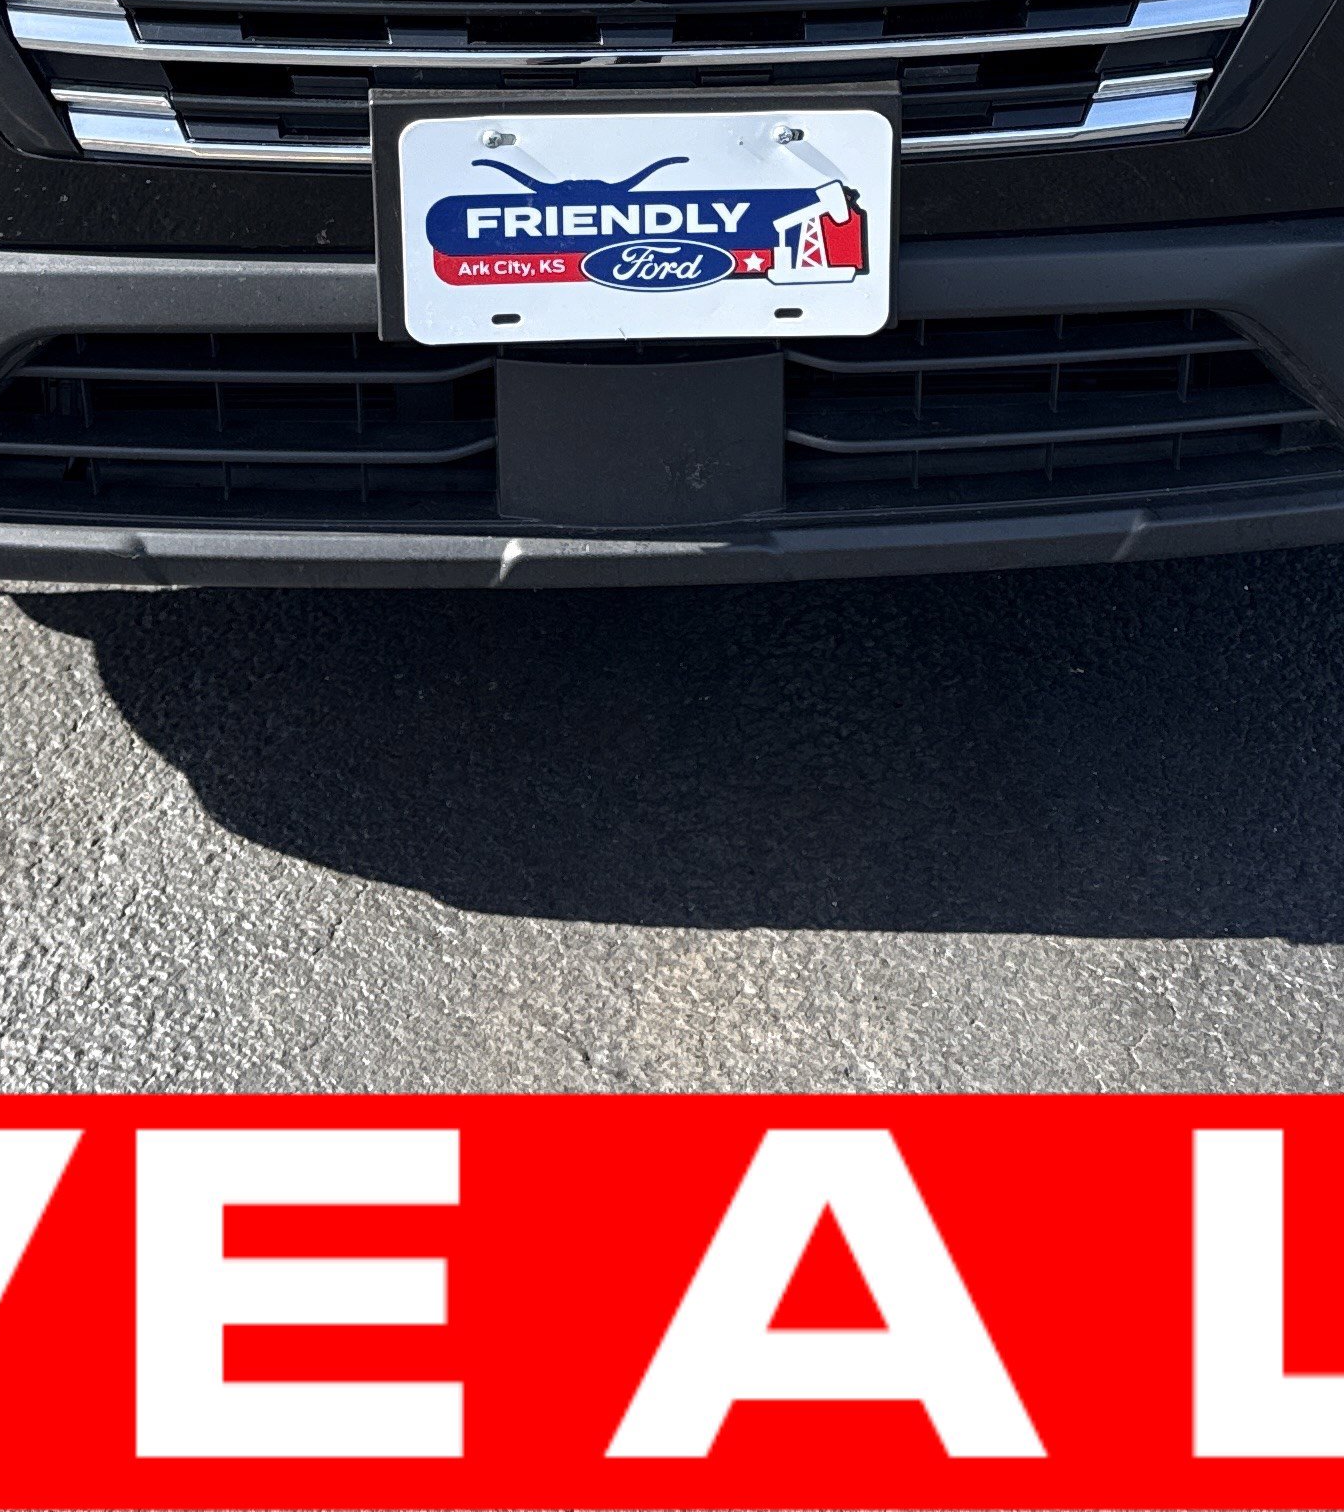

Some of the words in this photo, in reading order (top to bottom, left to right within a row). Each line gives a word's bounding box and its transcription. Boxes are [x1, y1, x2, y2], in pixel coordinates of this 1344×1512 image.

[466, 202, 751, 239] FRIENDLY
[458, 261, 490, 276] Ark
[493, 259, 536, 277] City,
[540, 258, 566, 274] KS
[612, 245, 704, 281] Ford
